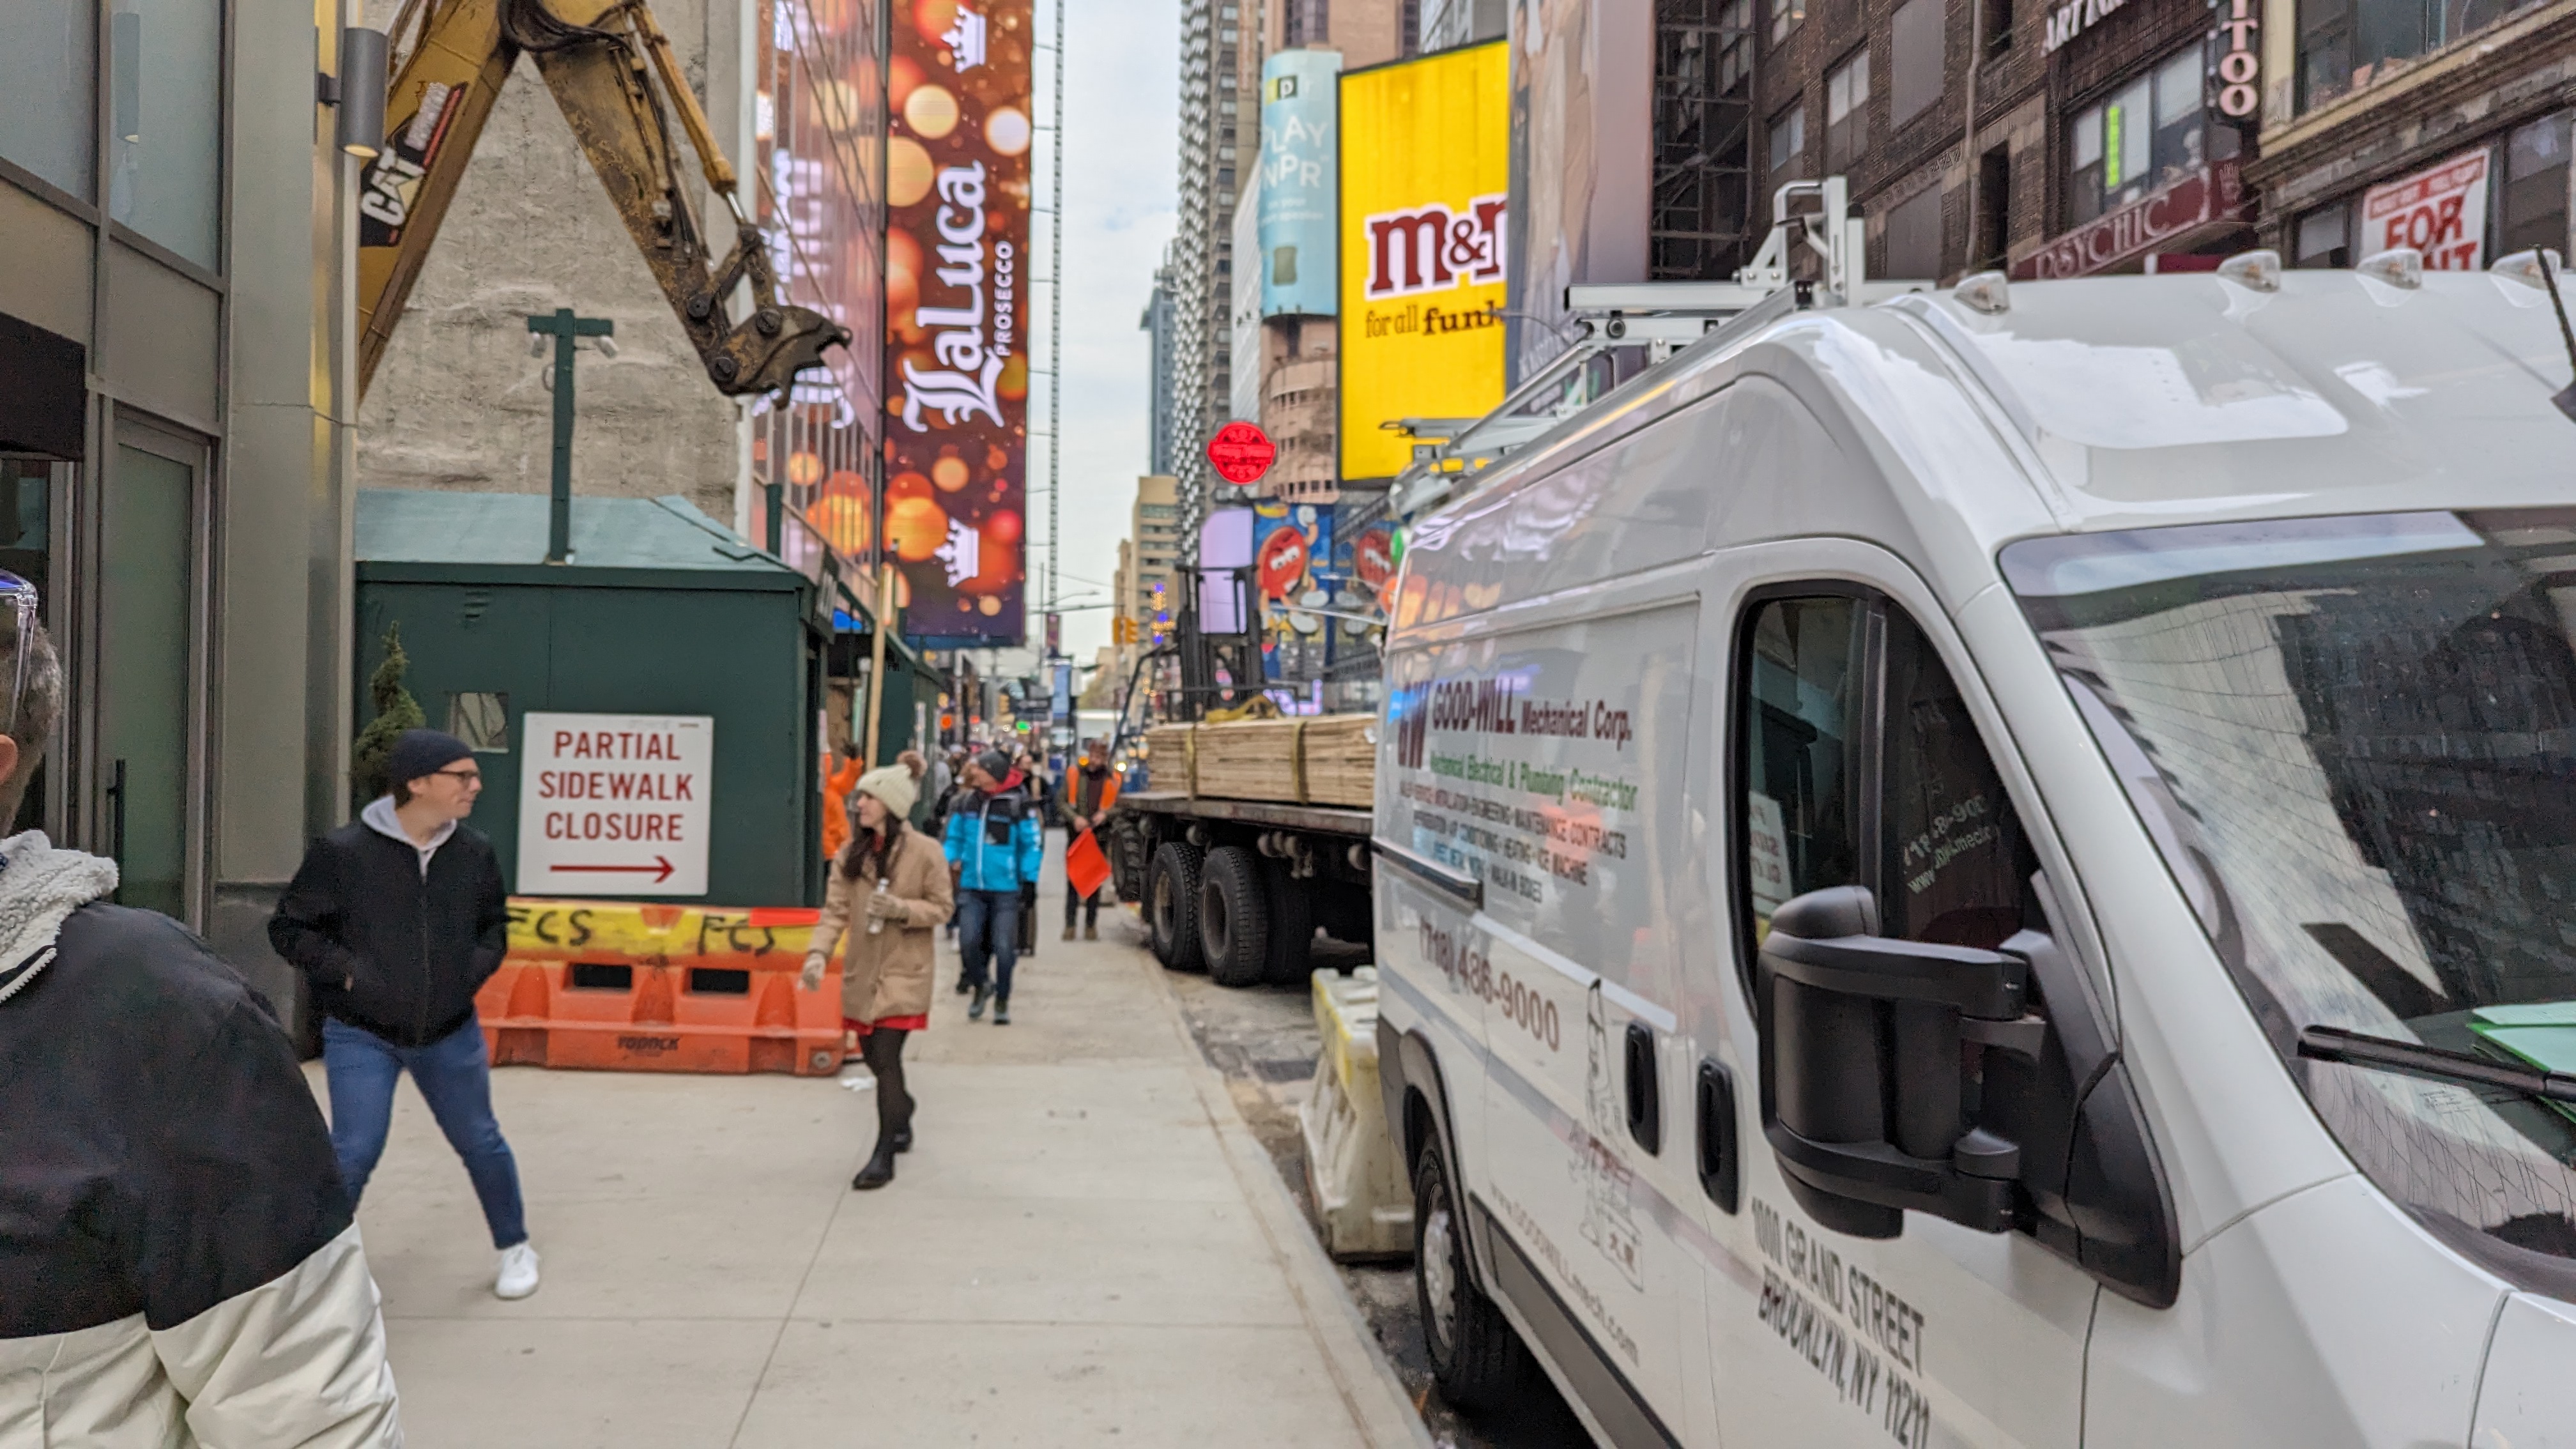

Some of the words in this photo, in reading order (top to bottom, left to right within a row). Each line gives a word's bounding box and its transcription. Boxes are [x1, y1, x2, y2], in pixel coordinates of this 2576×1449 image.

[1264, 115, 1328, 153] PLAY
[361, 146, 427, 227] CAT
[1264, 154, 1322, 190] NPR
[2035, 194, 2170, 279] PSYCHIC
[2385, 194, 2465, 250] FOR
[993, 240, 1014, 357] PROSECCO
[1365, 310, 1391, 338] for
[1394, 304, 1419, 334] all
[1432, 679, 1515, 733] GOOD-WILL
[1521, 700, 1590, 738] Mechanical
[1595, 700, 1633, 751] Corp.
[553, 731, 682, 761] PARTIAL
[539, 771, 694, 801] SIDEWALK
[1570, 767, 1638, 812] Contractor
[545, 812, 684, 841] CLOSURE
[1570, 822, 1627, 859] CONTRACTS
[1457, 945, 1560, 1052] 486-9000
[1785, 1218, 1843, 1315] GRAND
[1848, 1263, 1925, 1379] STREET
[1758, 1262, 1849, 1403] BROOKLYN,
[1849, 1337, 1880, 1415] NY
[1883, 1365, 1930, 1449] 11211
